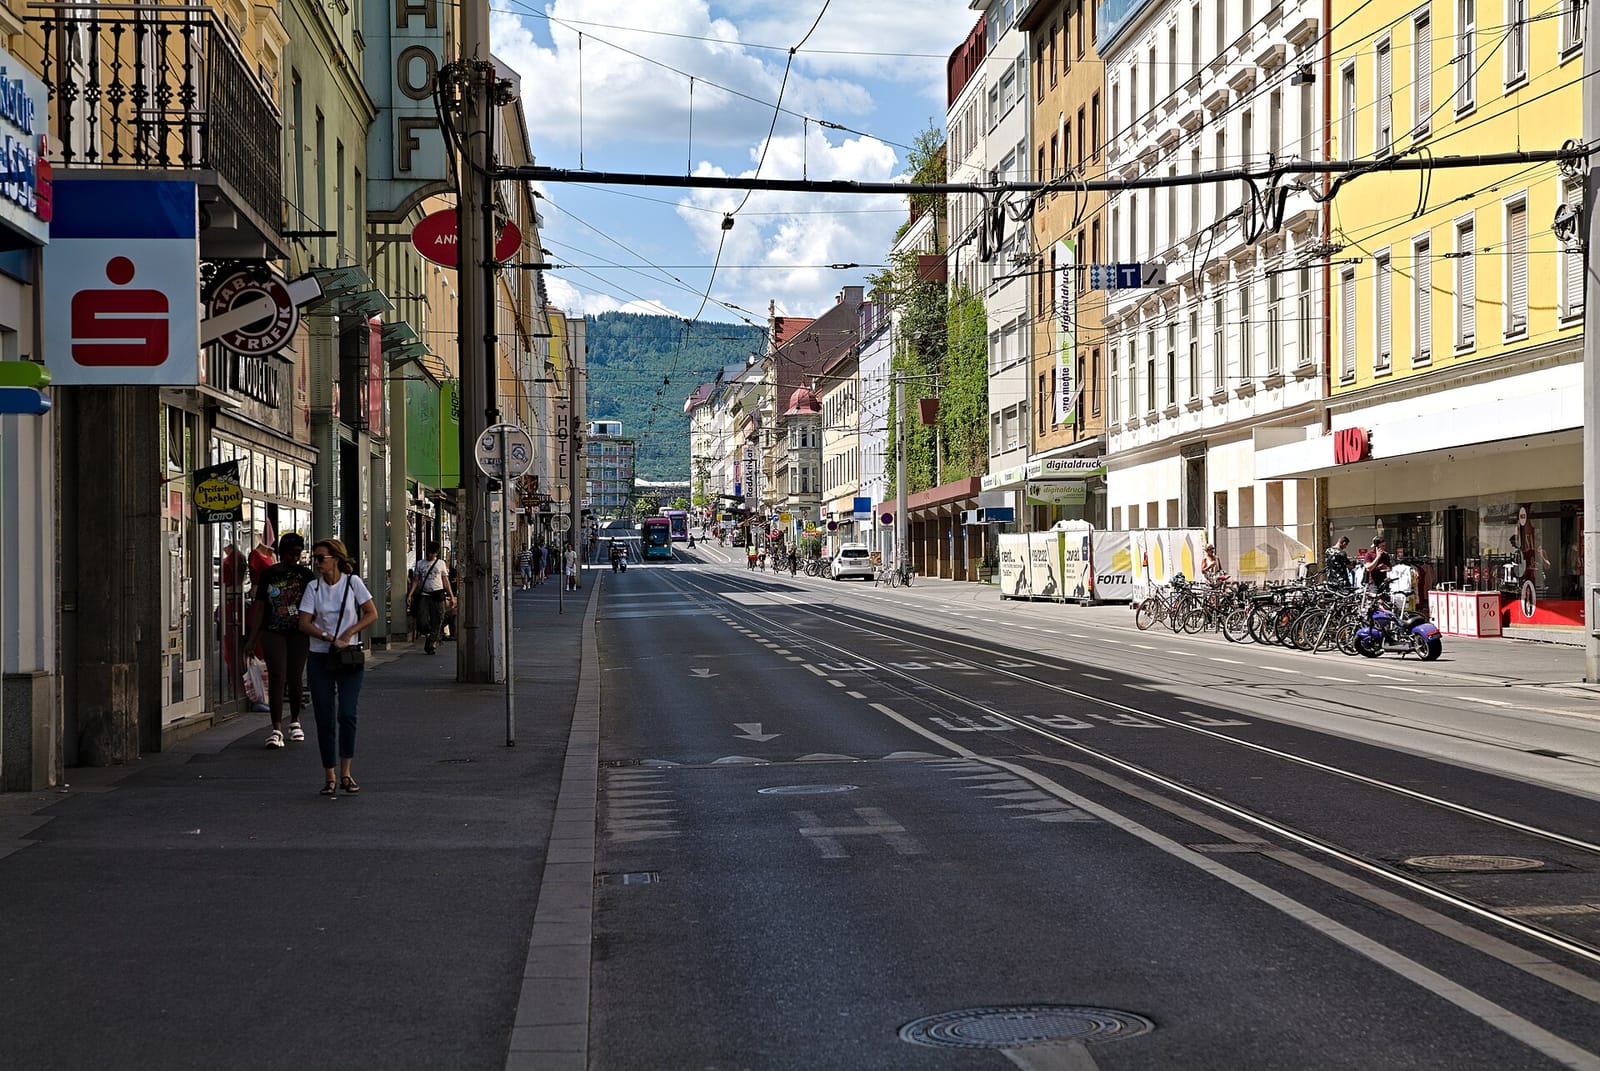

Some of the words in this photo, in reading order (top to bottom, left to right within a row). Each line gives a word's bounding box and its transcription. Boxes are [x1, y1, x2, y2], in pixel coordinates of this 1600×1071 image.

[1062, 263, 1071, 332] digitaldruck
[234, 306, 291, 349] TRAFIK
[1061, 368, 1070, 395] mente
[557, 414, 568, 480] HOTEL
[1334, 427, 1364, 464] NKD
[1046, 459, 1103, 471] digitaldruck
[198, 486, 229, 494] Dreifach
[1043, 485, 1085, 496] digitaldruck
[202, 492, 240, 505] Jackpot
[208, 511, 233, 522] LOTTO
[1097, 575, 1127, 585] FOITL
